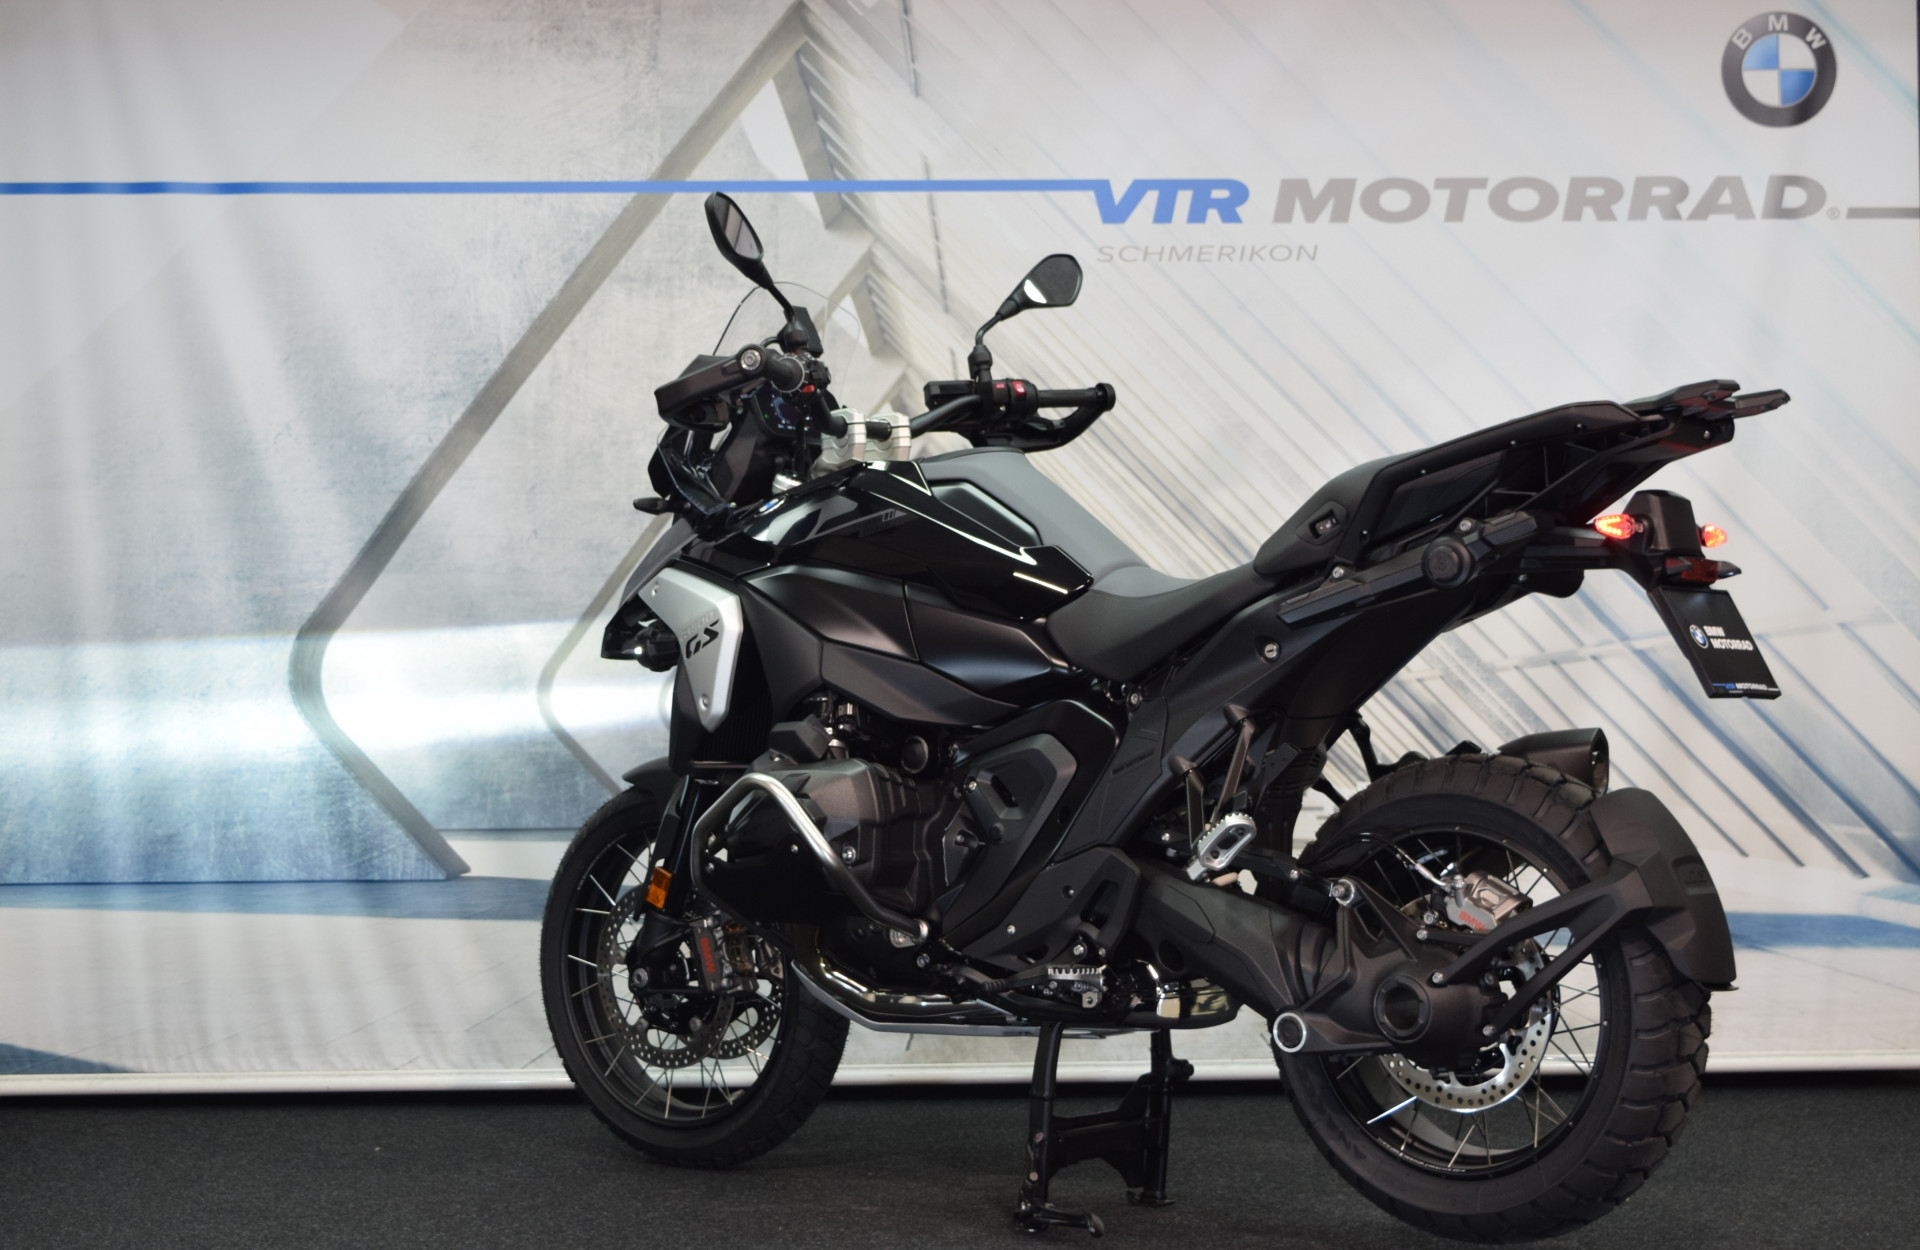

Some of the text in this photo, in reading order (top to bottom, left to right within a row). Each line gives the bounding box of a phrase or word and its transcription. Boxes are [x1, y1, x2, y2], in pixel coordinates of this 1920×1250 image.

[1731, 13, 1827, 50] BMW
[1092, 173, 1827, 224] VTR MOTORRAD
[1097, 243, 1319, 263] SCHMERIKON
[685, 619, 720, 659] GS
[1710, 638, 1754, 651] MOTORRAD
[1458, 910, 1486, 932] BMW
[701, 937, 716, 973] BMW
